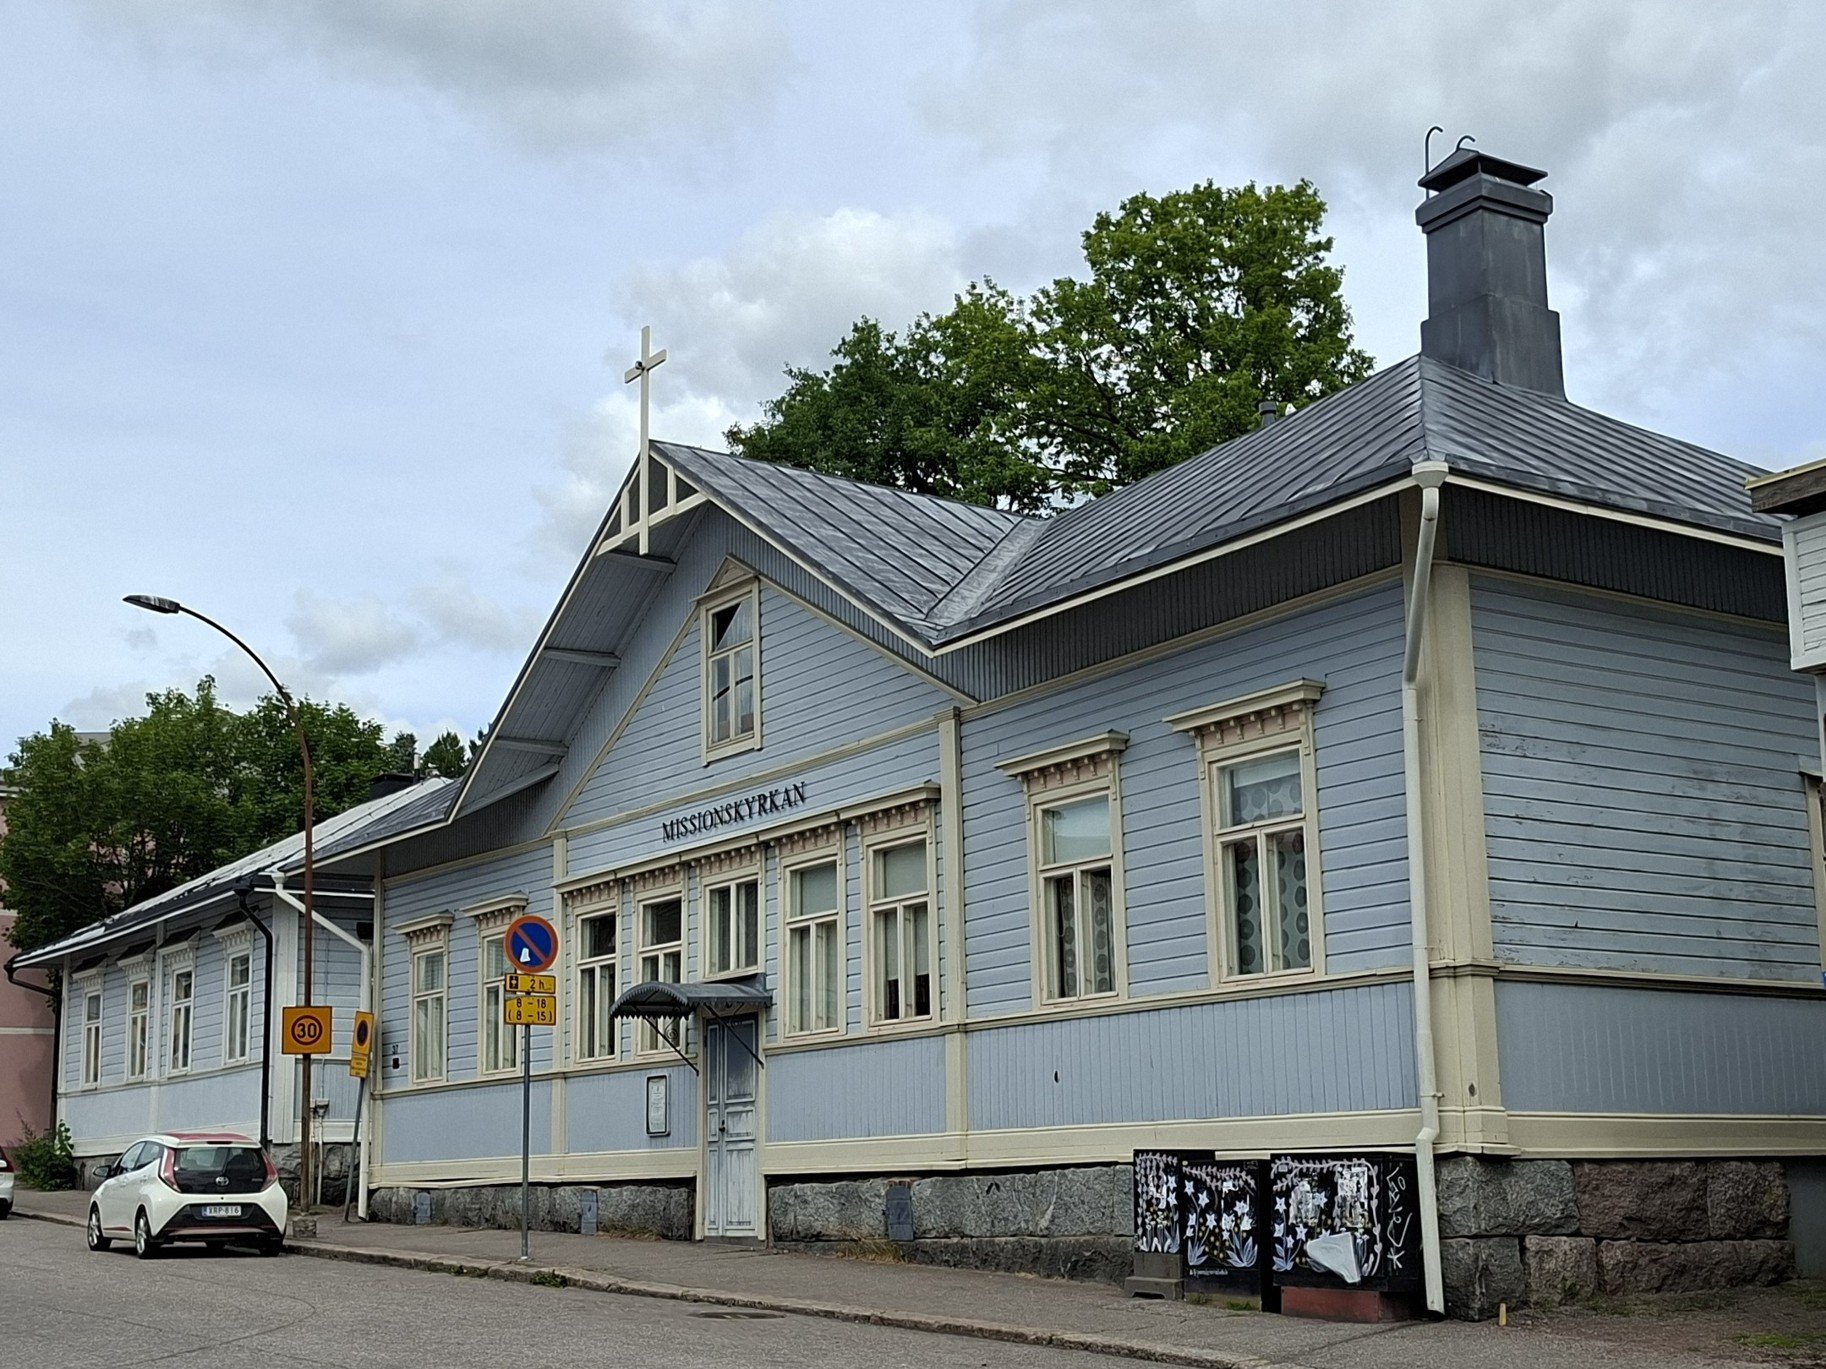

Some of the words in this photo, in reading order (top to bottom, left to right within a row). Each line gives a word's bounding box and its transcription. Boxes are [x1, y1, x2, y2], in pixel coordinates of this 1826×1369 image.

[662, 781, 807, 843] MISSIONSKYRKAN
[530, 979, 536, 989] 2
[538, 979, 545, 990] h
[297, 1022, 317, 1039] 30
